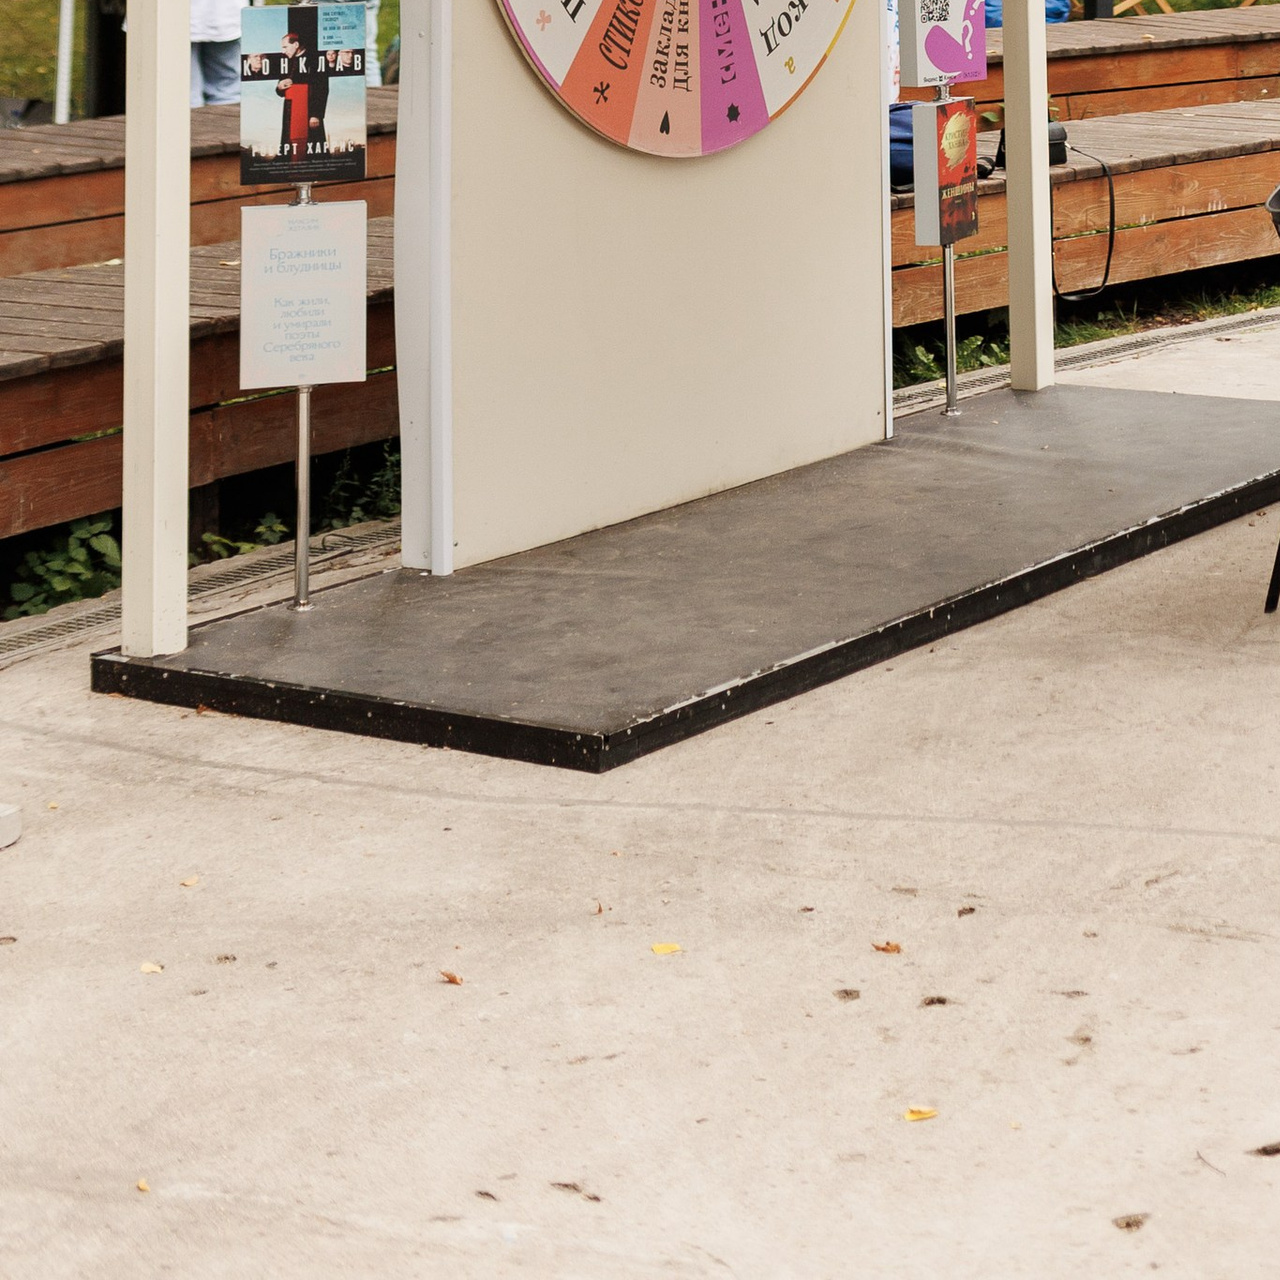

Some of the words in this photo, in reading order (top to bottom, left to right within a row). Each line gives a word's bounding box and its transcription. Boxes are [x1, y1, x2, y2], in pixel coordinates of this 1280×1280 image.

[243, 53, 362, 77] КОНКЛАВ
[672, 42, 693, 92] для
[269, 247, 337, 262] Бражники
[264, 265, 273, 274] и
[277, 261, 342, 275] блудницы
[263, 339, 342, 354] Серебряного
